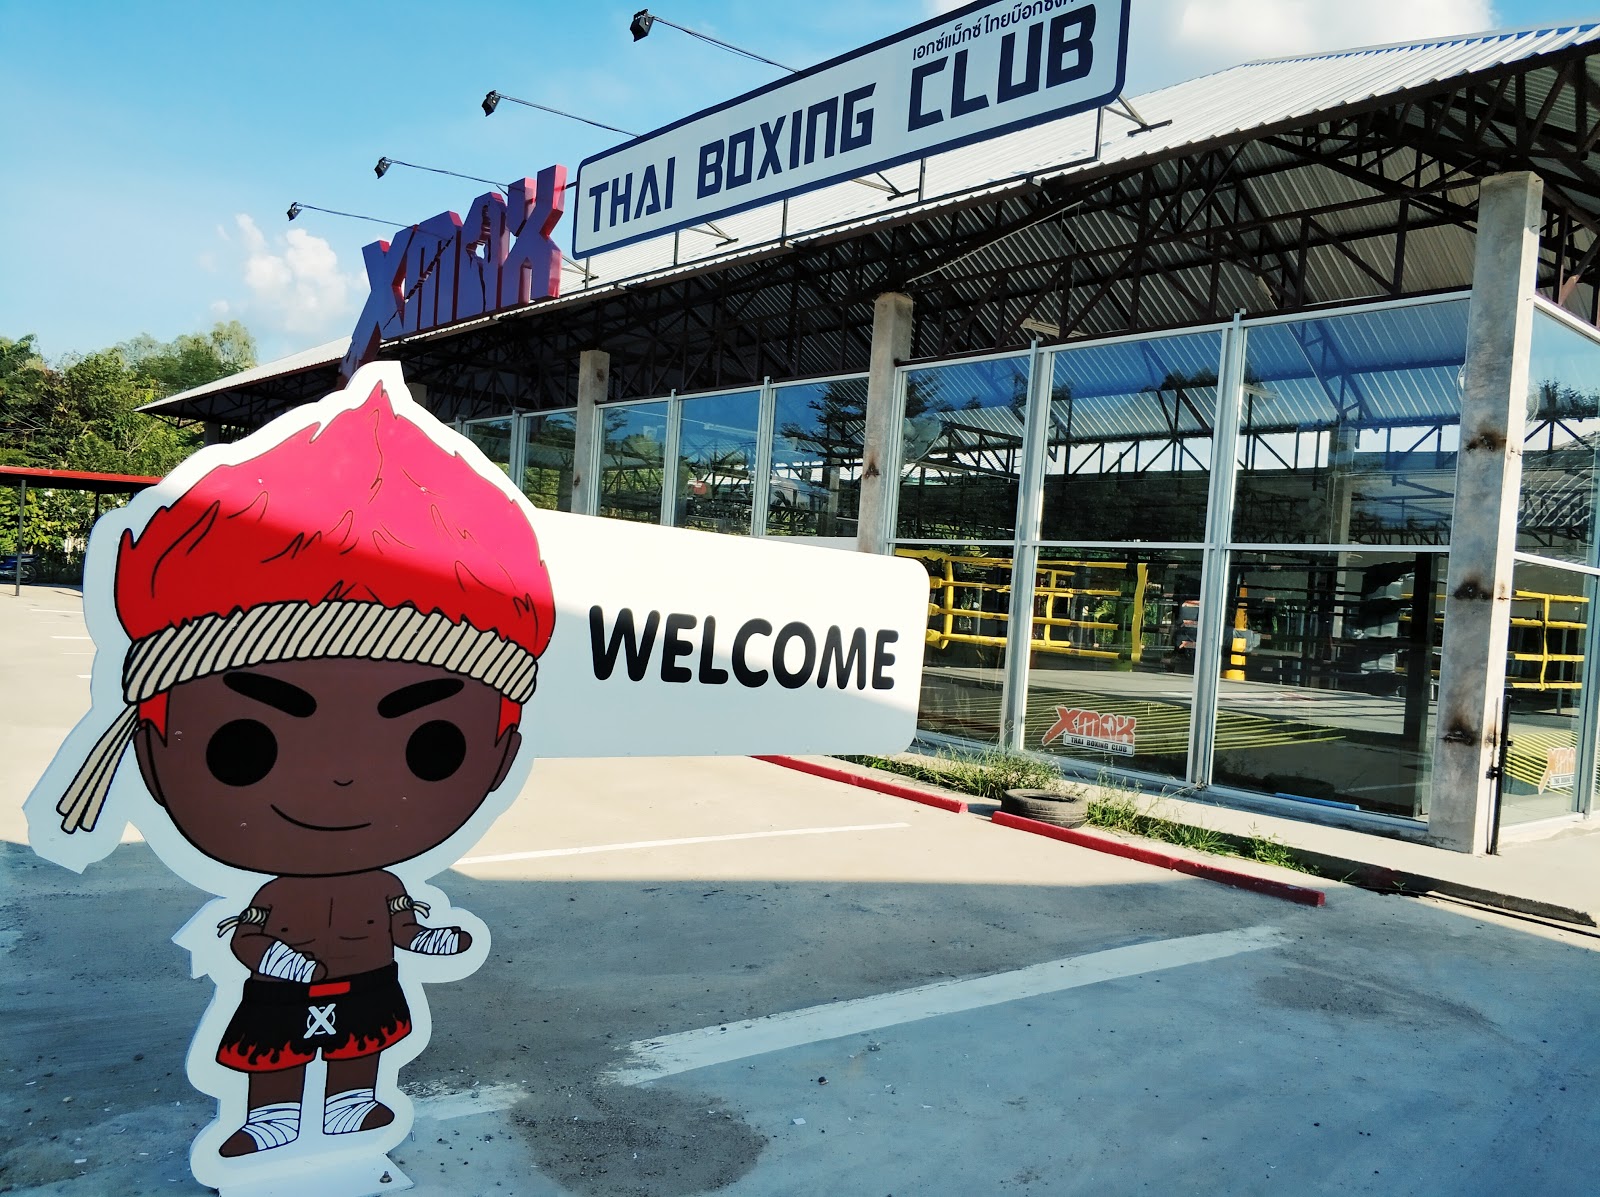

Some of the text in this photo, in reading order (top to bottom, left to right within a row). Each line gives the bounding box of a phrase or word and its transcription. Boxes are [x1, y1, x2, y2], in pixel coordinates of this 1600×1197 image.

[588, 3, 1098, 233] THAI BOXING CLUB
[589, 605, 899, 691] WELCOME
[1071, 737, 1084, 745] THAI
[1111, 744, 1128, 753] CLUB
